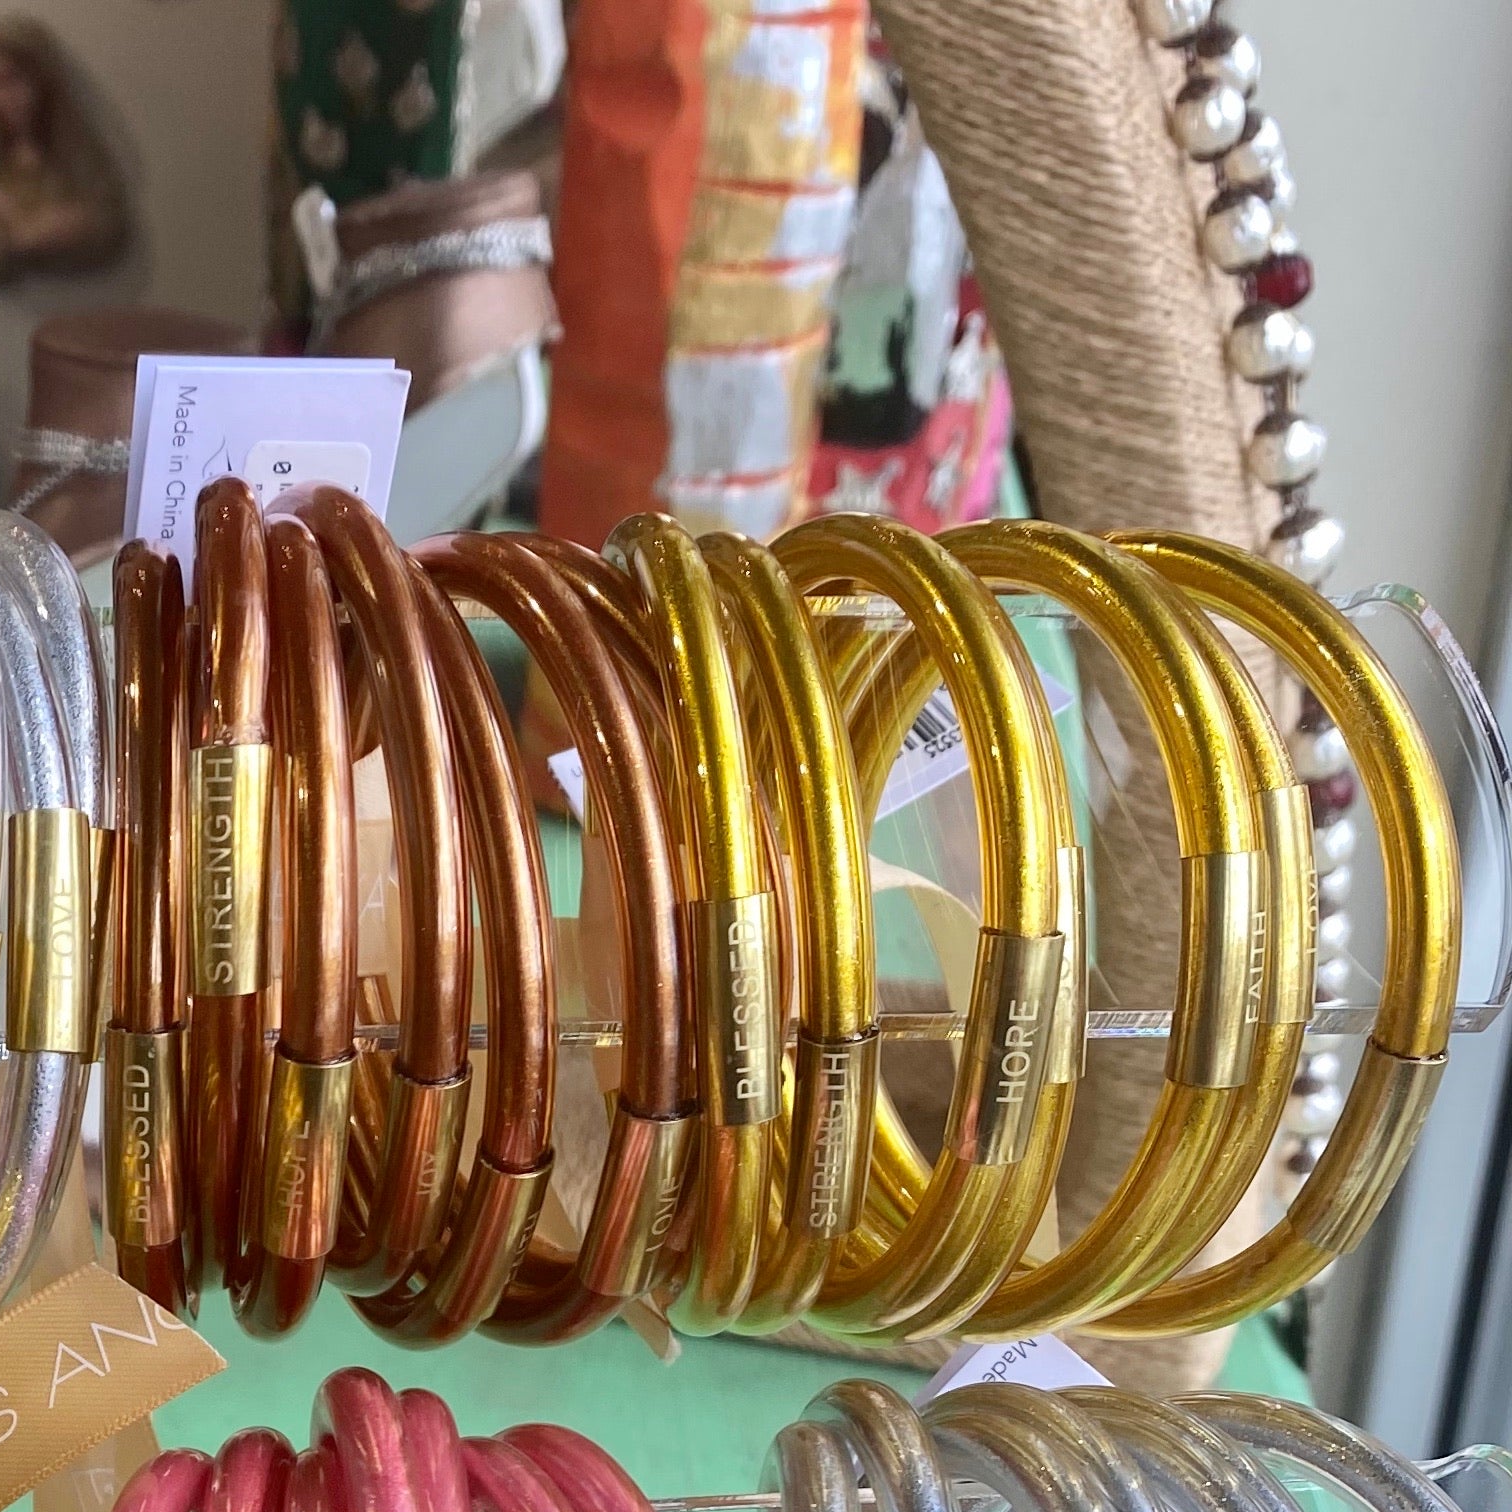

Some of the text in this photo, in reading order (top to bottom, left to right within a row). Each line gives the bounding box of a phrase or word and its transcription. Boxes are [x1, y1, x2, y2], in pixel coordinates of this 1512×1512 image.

[160, 385, 198, 541] Made in China
[51, 877, 76, 980] LOVE
[1245, 909, 1268, 1025] FAITH
[728, 918, 766, 1100] BLESSED
[808, 1051, 851, 1231] STRENGTH
